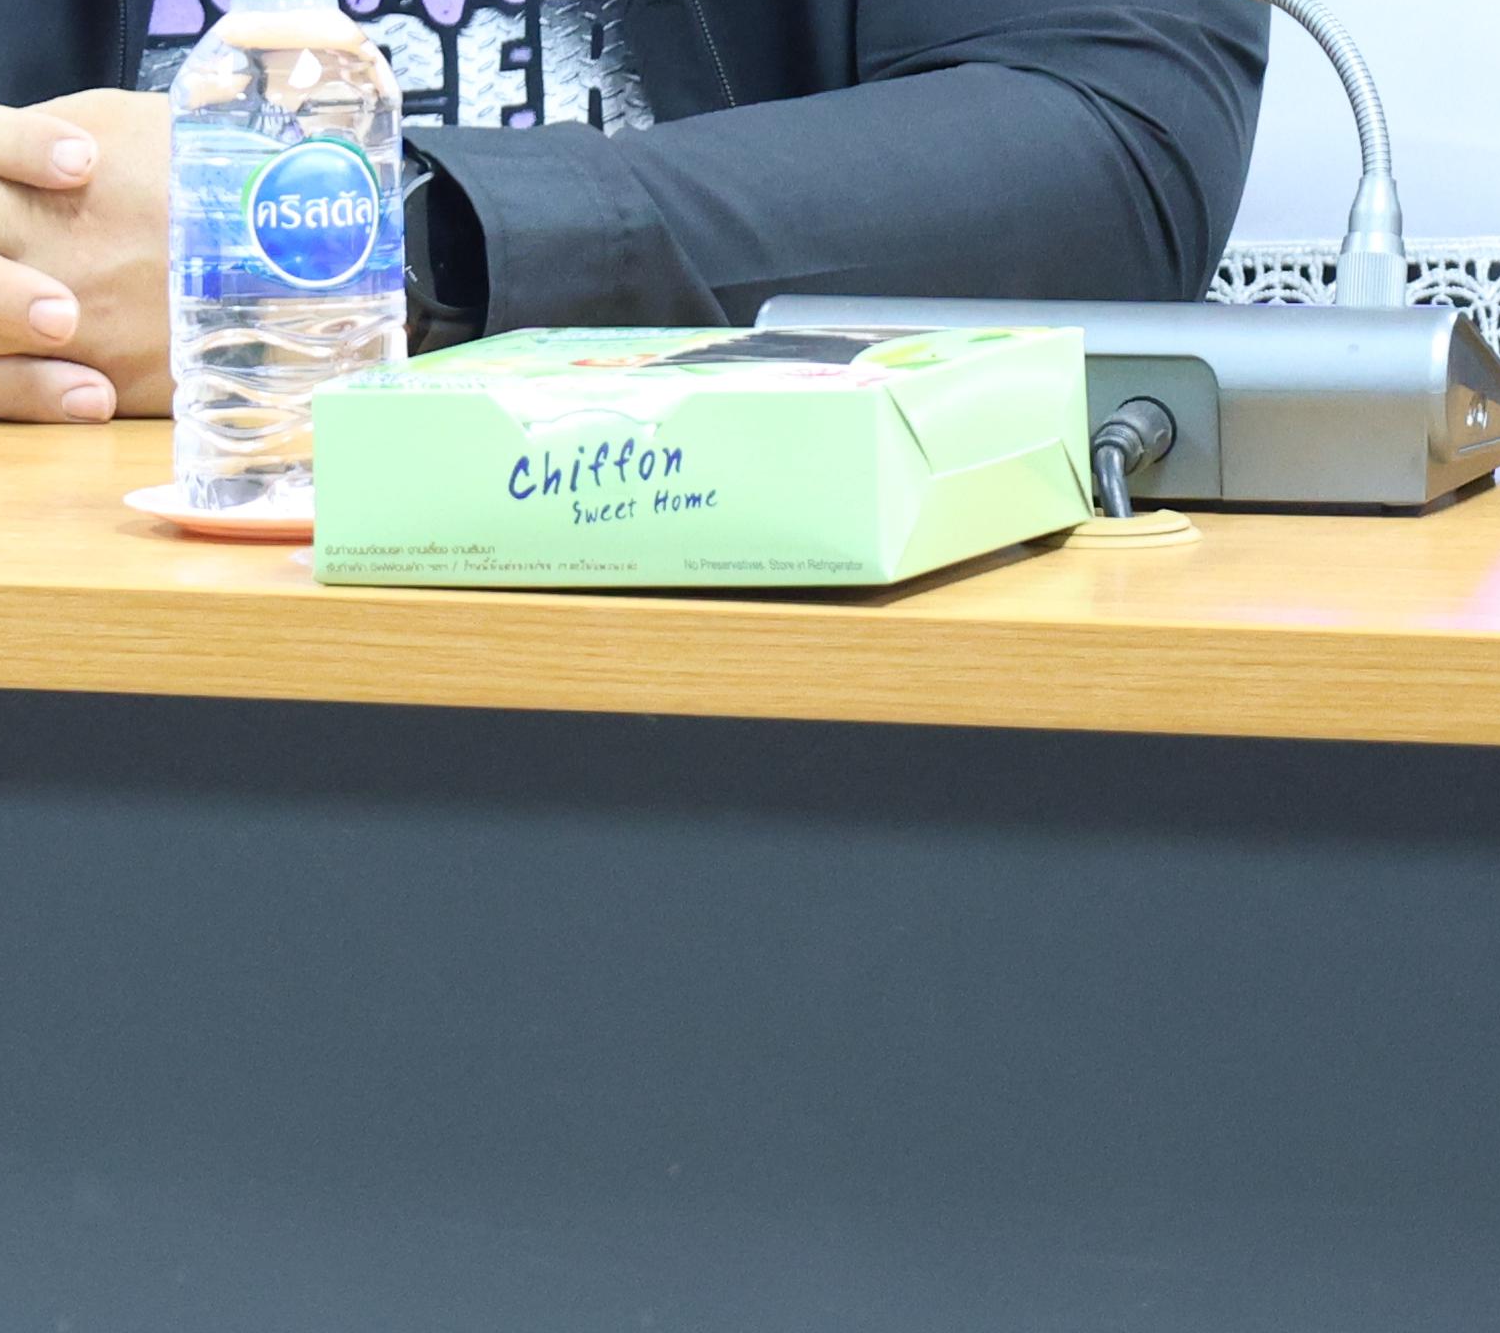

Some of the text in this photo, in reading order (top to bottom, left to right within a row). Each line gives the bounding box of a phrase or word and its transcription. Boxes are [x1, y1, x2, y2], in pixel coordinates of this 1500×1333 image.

[256, 189, 373, 235] คริสตัล
[508, 437, 683, 500] Chiffon
[572, 489, 719, 525] Sweet Home
